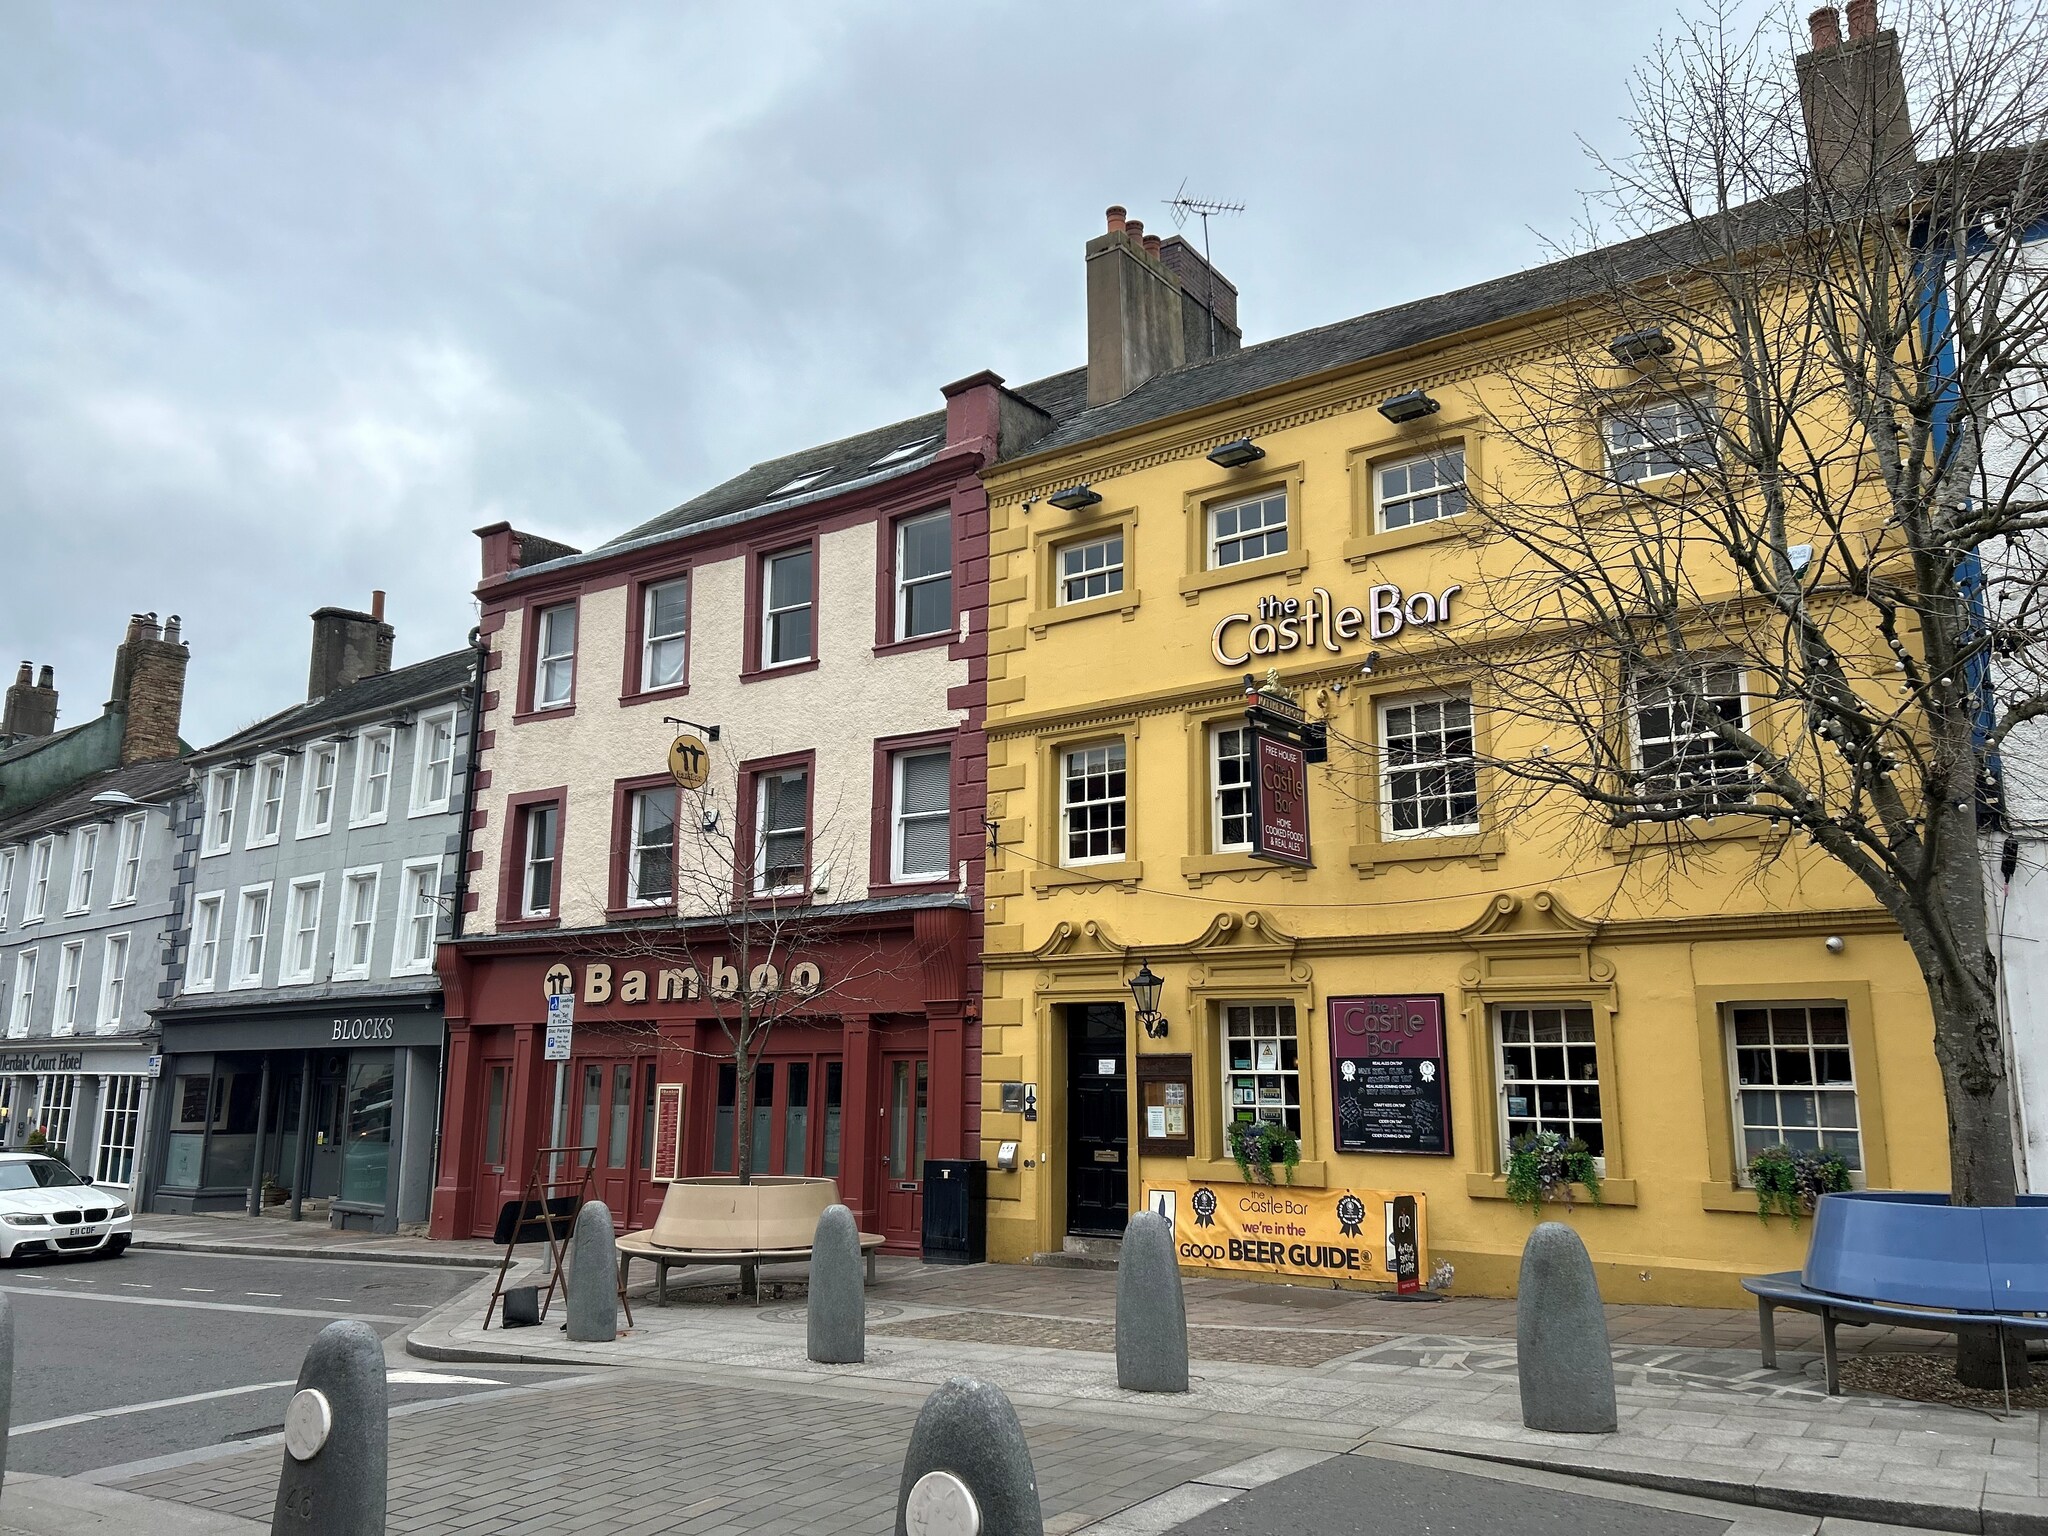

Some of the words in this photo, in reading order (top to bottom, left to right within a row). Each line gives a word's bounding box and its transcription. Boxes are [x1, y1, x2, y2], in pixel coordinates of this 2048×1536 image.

[1257, 594, 1298, 620] the
[1211, 586, 1364, 667] Castle
[1369, 584, 1462, 641] Bar
[1265, 744, 1278, 757] FREE
[1278, 750, 1298, 763] HOUSE
[1262, 763, 1303, 801] Castle
[1274, 790, 1293, 814] Bar
[1265, 824, 1287, 838] COOKED
[1287, 830, 1304, 843] FOODS
[1276, 817, 1292, 830] HOME
[1270, 836, 1275, 846] &
[1274, 838, 1288, 849] REAL
[1288, 841, 1301, 852] ALES
[583, 956, 822, 1003] Bamboo
[1368, 1001, 1389, 1014] the
[331, 1017, 394, 1040] BLOCKS
[1344, 1002, 1425, 1037] Castle
[1367, 1033, 1403, 1057] Bar
[31, 1053, 57, 1072] Court
[58, 1052, 82, 1071] Hotel
[1251, 1190, 1265, 1200] the
[1239, 1196, 1284, 1215] Castle
[1285, 1200, 1308, 1215] Bar
[81, 1226, 96, 1235] CDF
[1242, 1221, 1273, 1235] we're
[1274, 1222, 1285, 1236] in
[1286, 1222, 1306, 1237] the
[1180, 1243, 1225, 1259] GOOD
[1228, 1238, 1285, 1267] BEER
[1288, 1243, 1361, 1271] GUIDE
